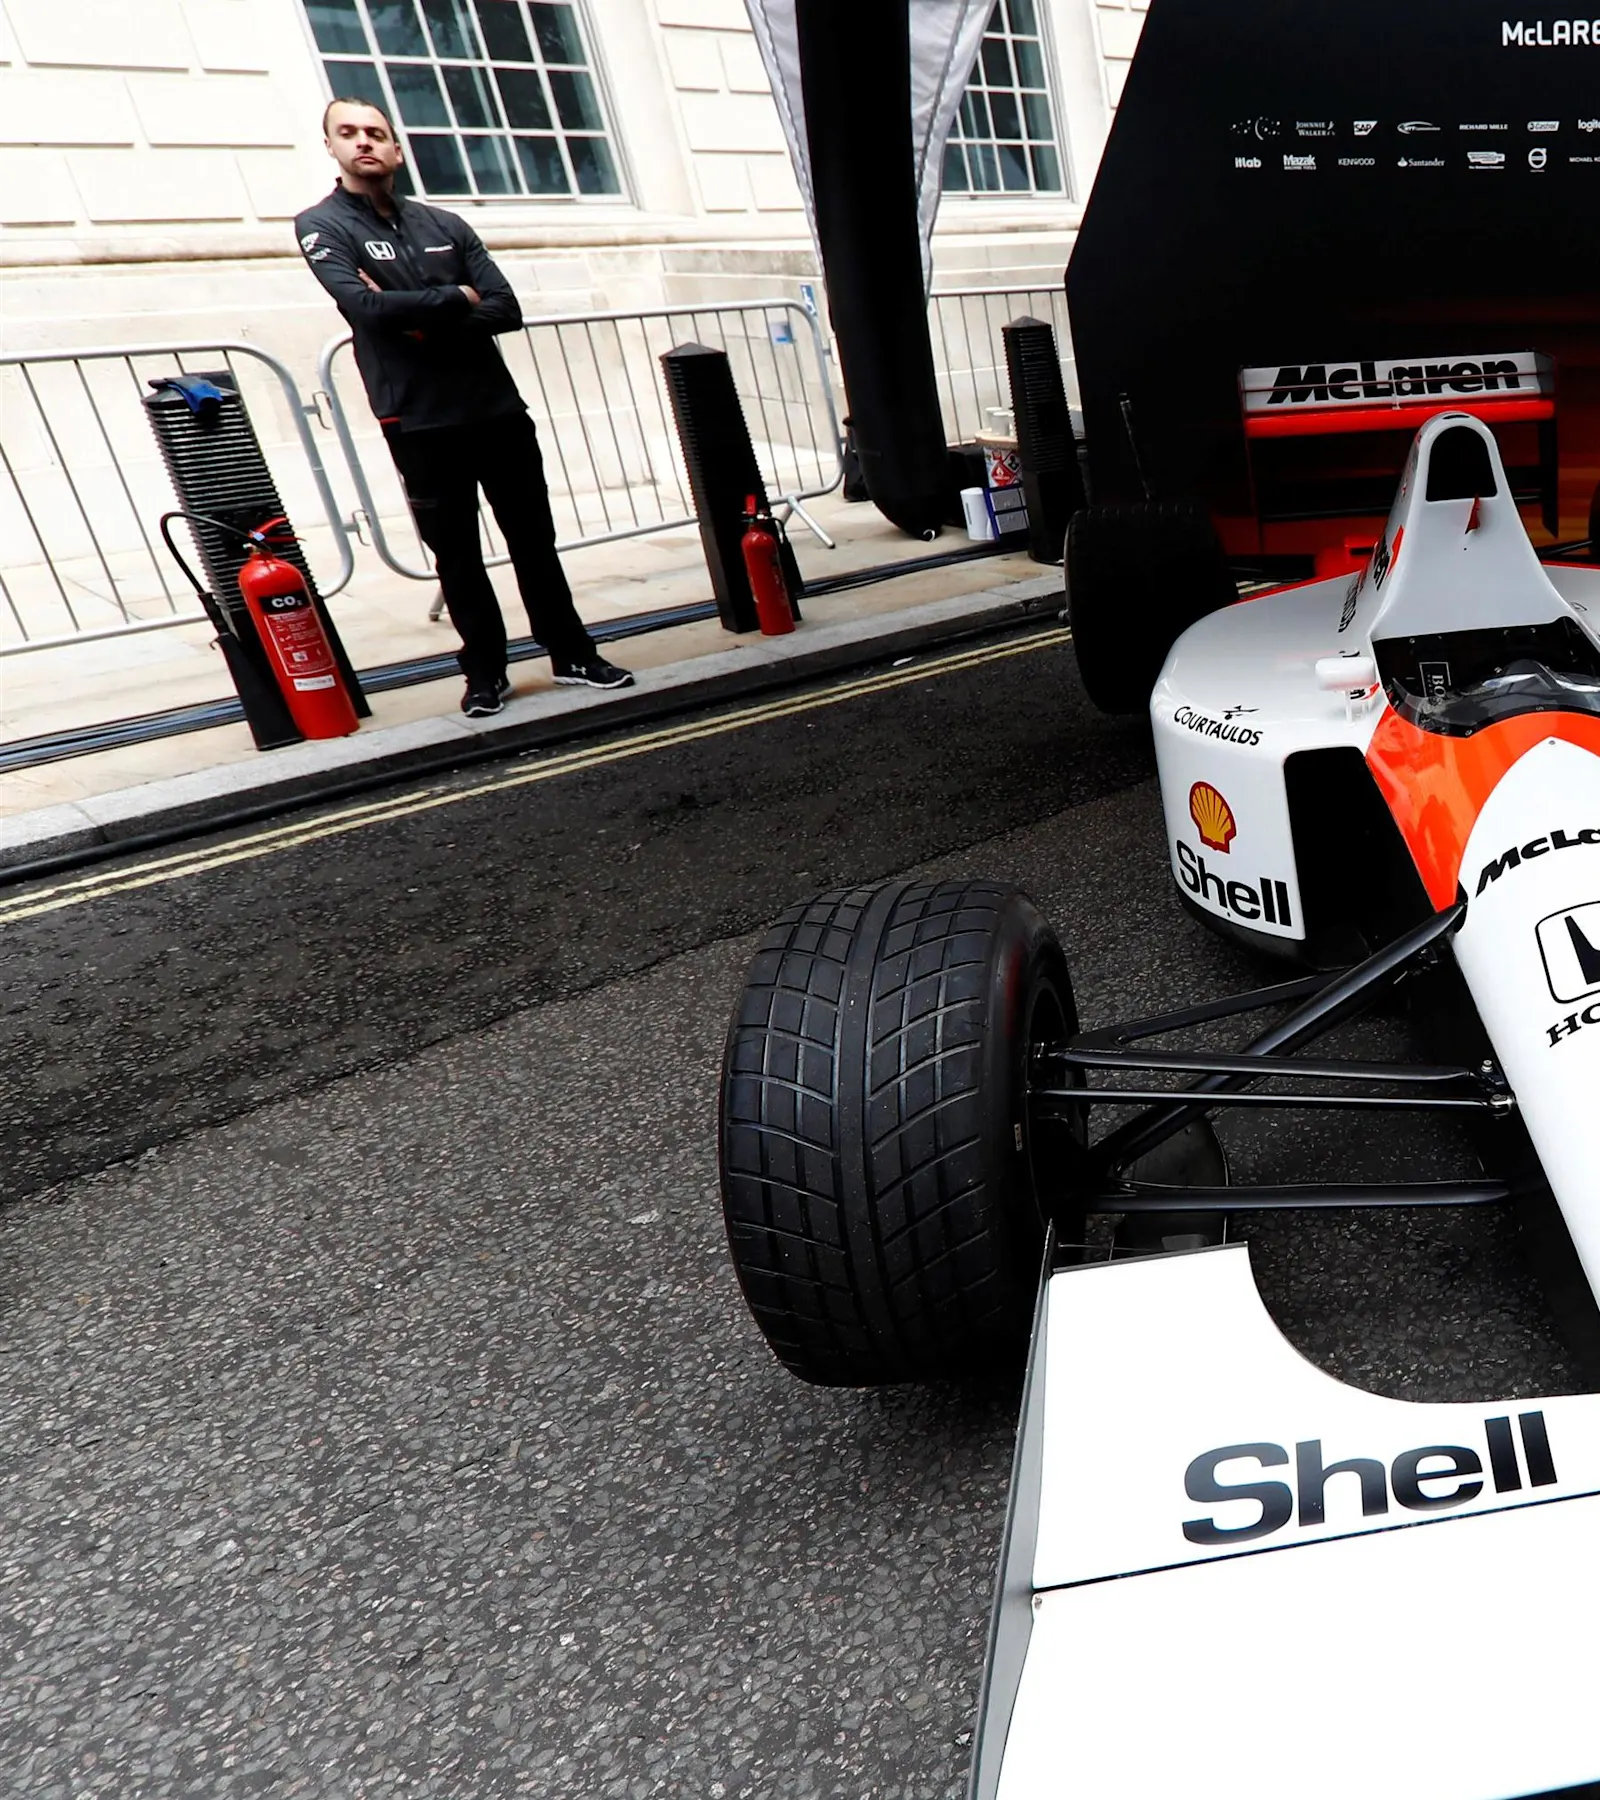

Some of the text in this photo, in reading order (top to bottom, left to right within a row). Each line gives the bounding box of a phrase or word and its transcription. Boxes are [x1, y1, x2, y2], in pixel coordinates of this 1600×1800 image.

[1283, 154, 1316, 166] Mazak
[1338, 158, 1375, 166] KENWOOD
[1408, 159, 1445, 167] Santander
[1267, 359, 1520, 405] McLaren
[1173, 706, 1264, 746] COURTAULDS
[1176, 839, 1292, 927] Shell
[1182, 1410, 1557, 1545] Shell
